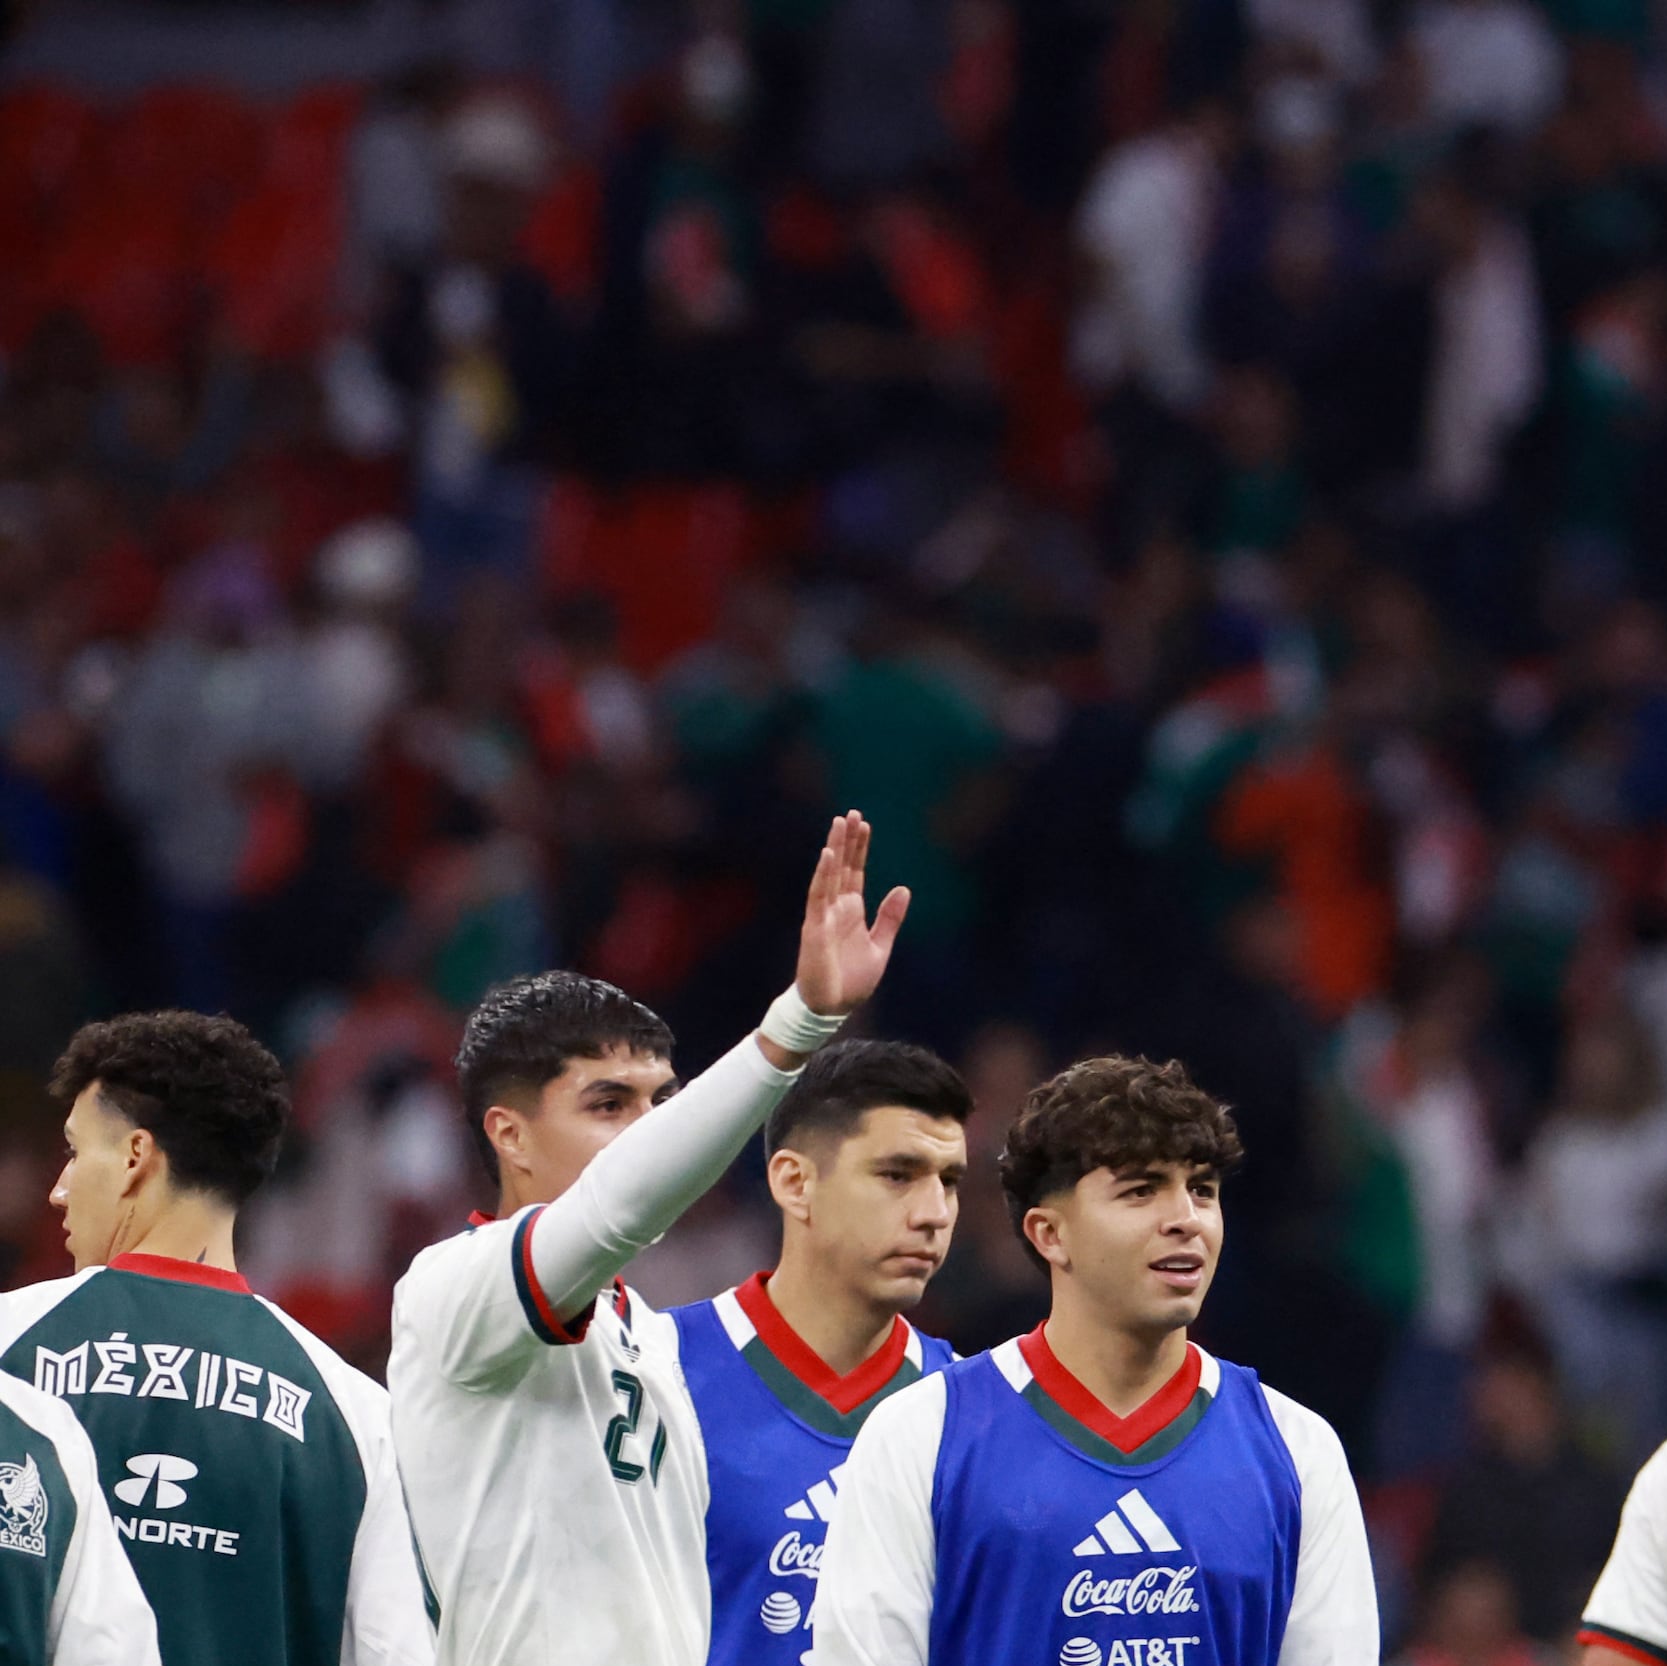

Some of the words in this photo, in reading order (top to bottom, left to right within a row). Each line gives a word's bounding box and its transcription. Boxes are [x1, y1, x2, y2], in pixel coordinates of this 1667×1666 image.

[34, 1331, 313, 1444] MÉXICO
[0, 1530, 42, 1552] ÉXICO
[1062, 1566, 1198, 1617] Coca-Cola
